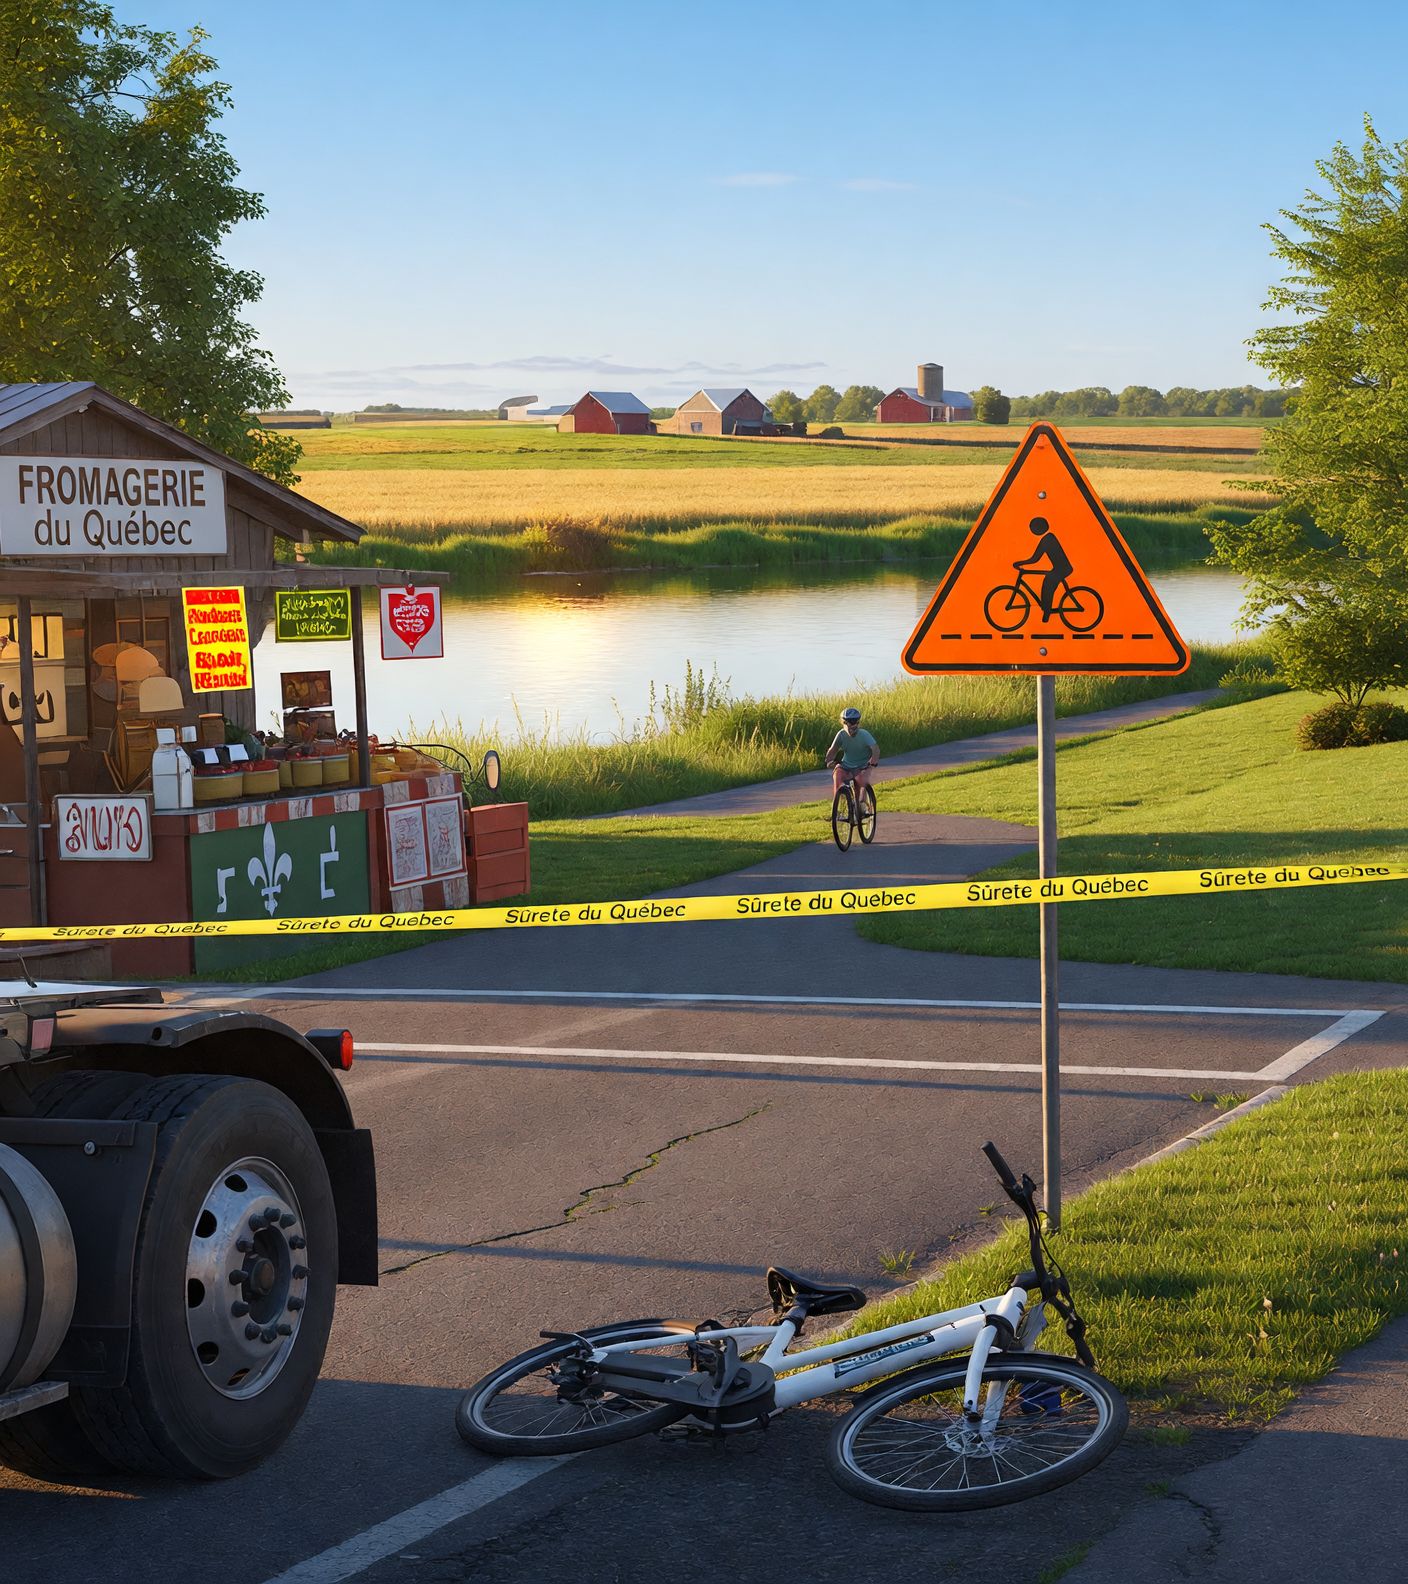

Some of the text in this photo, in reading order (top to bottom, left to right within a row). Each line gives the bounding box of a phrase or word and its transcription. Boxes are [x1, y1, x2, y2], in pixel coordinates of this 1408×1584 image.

[18, 464, 206, 507] FROMAGERIE
[34, 509, 193, 550] du Québec
[1274, 868, 1300, 882] du
[1040, 880, 1064, 897] du
[808, 893, 833, 910] du
[578, 905, 602, 920] du
[123, 925, 147, 936] du
[348, 916, 372, 929] du
